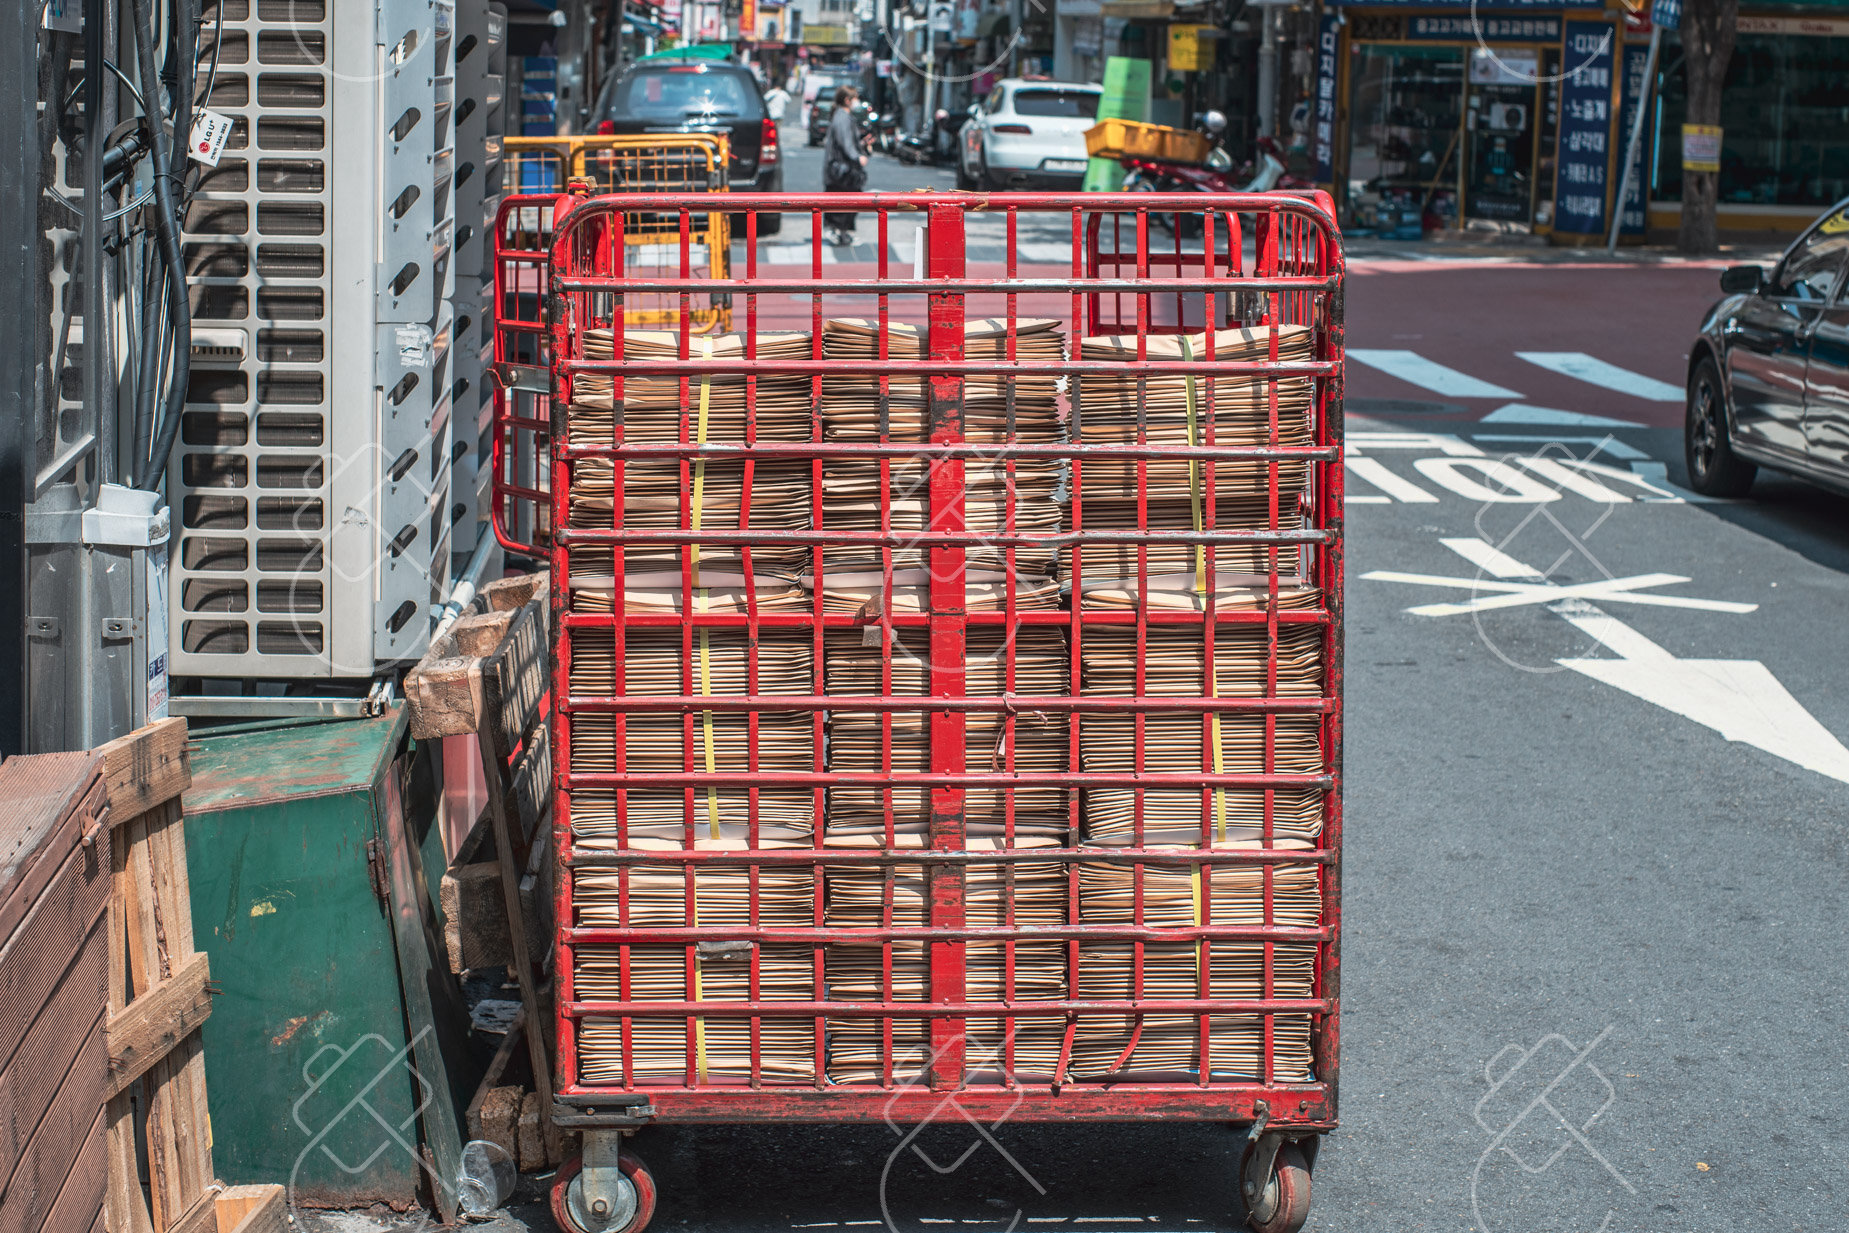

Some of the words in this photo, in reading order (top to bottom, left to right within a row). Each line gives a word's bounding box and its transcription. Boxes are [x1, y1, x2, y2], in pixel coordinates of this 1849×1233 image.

[204, 130, 212, 142] LG
[208, 120, 214, 130] U+
[1569, 130, 1605, 152] 삼각대
